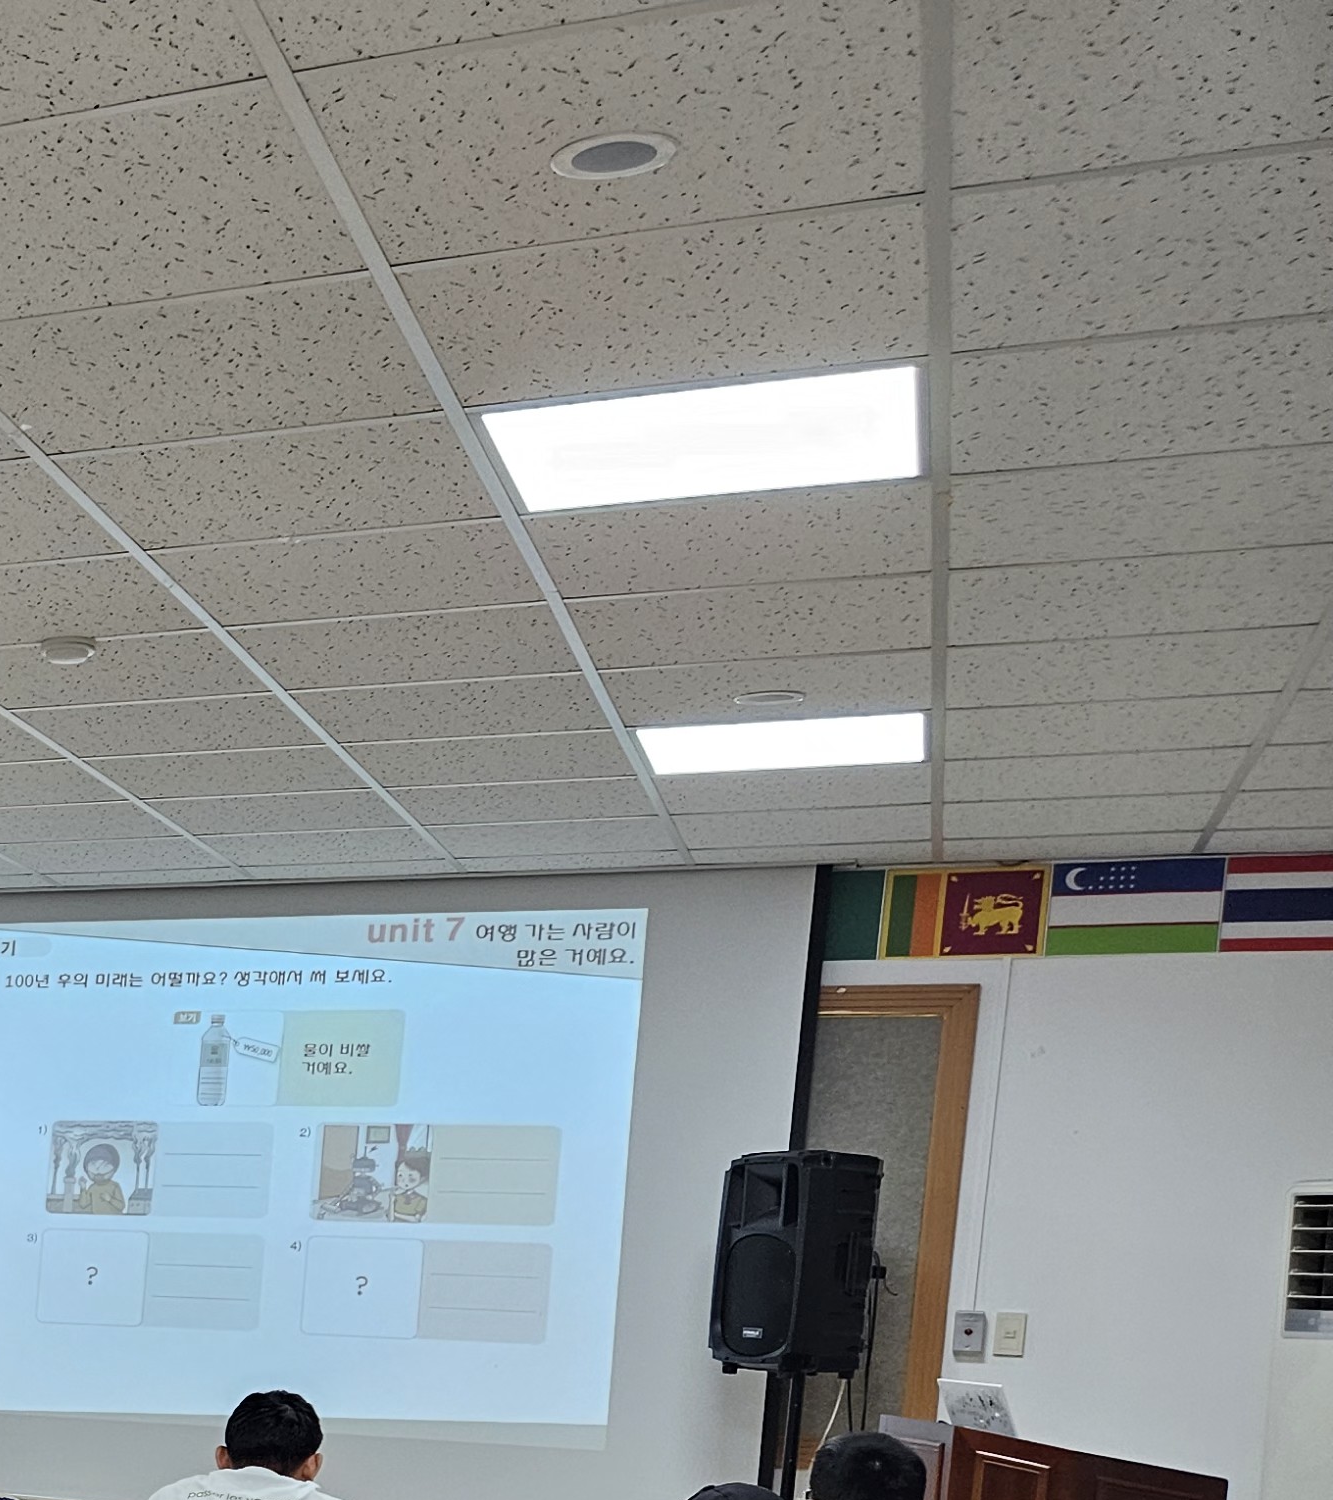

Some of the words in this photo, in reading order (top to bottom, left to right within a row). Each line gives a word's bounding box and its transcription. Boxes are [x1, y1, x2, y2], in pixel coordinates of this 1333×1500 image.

[367, 918, 435, 943] unit
[446, 917, 466, 942] 7
[524, 923, 566, 941] 가는
[572, 921, 637, 941] 사람이
[517, 948, 558, 967] 많은
[565, 947, 635, 967] 거예요.
[5, 972, 50, 989] 100년
[96, 970, 142, 988] 미래는
[151, 969, 228, 988] 어떨까요?
[309, 968, 327, 986] 써
[334, 967, 393, 985] 보세요.
[303, 1043, 333, 1057] 물이
[340, 1043, 371, 1058] 비쌀
[302, 1061, 353, 1075] 거예요.
[300, 1126, 312, 1138] 2)
[27, 1233, 37, 1244] 3)
[290, 1240, 302, 1252] 4)
[86, 1266, 99, 1286] ?
[355, 1275, 369, 1296] ?
